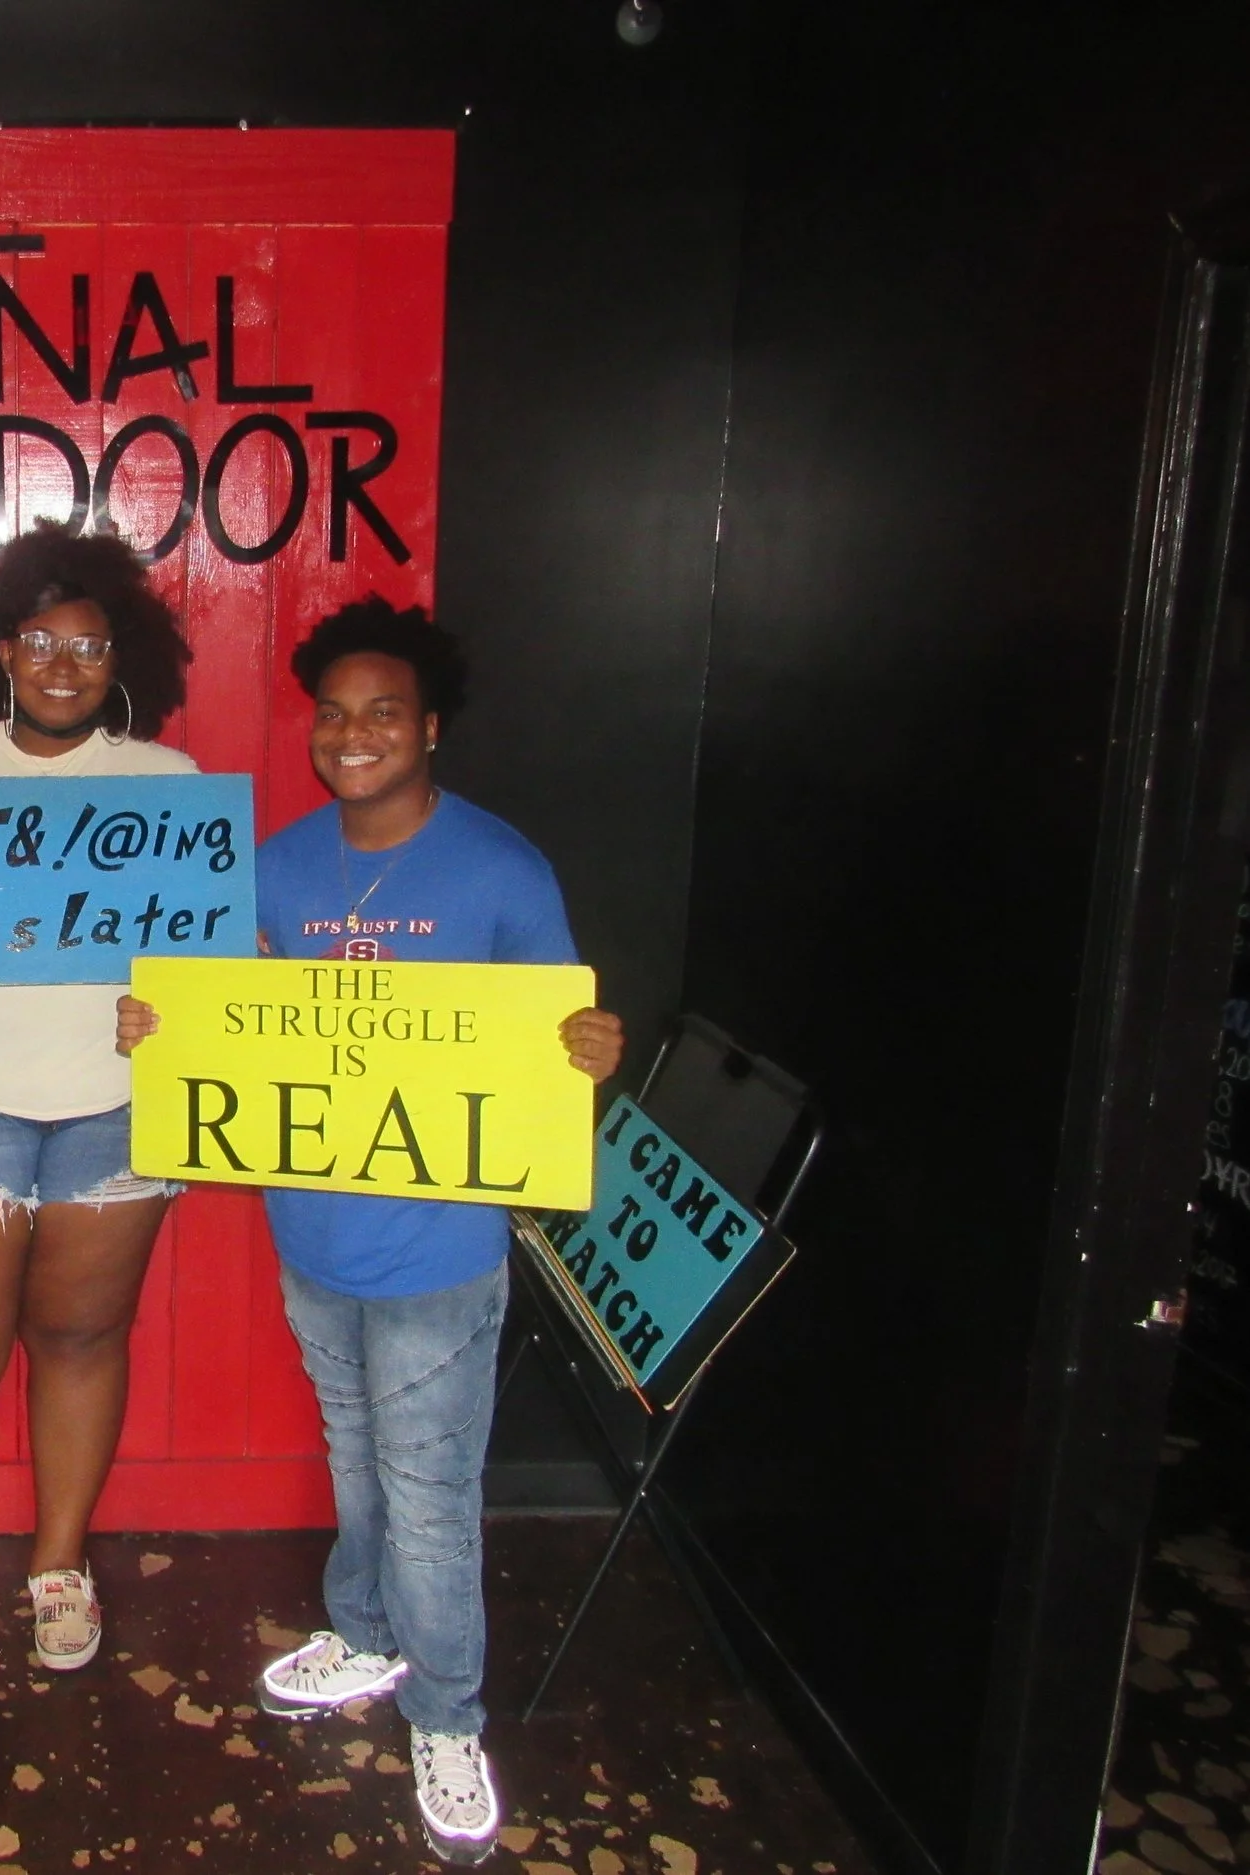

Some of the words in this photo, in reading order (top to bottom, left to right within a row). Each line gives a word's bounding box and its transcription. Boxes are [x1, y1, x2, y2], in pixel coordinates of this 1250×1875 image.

[56, 891, 231, 951] Later
[303, 921, 341, 935] IT'S
[350, 920, 399, 935] JUST
[408, 919, 434, 935] IN
[302, 967, 394, 1002] THE
[224, 1003, 478, 1044] STRUGGLE
[329, 1044, 367, 1078] IS
[176, 1076, 531, 1194] REAL
[603, 1106, 632, 1147] I
[629, 1132, 748, 1263] CAME
[607, 1193, 659, 1263] TO
[542, 1212, 665, 1371] WATCH
